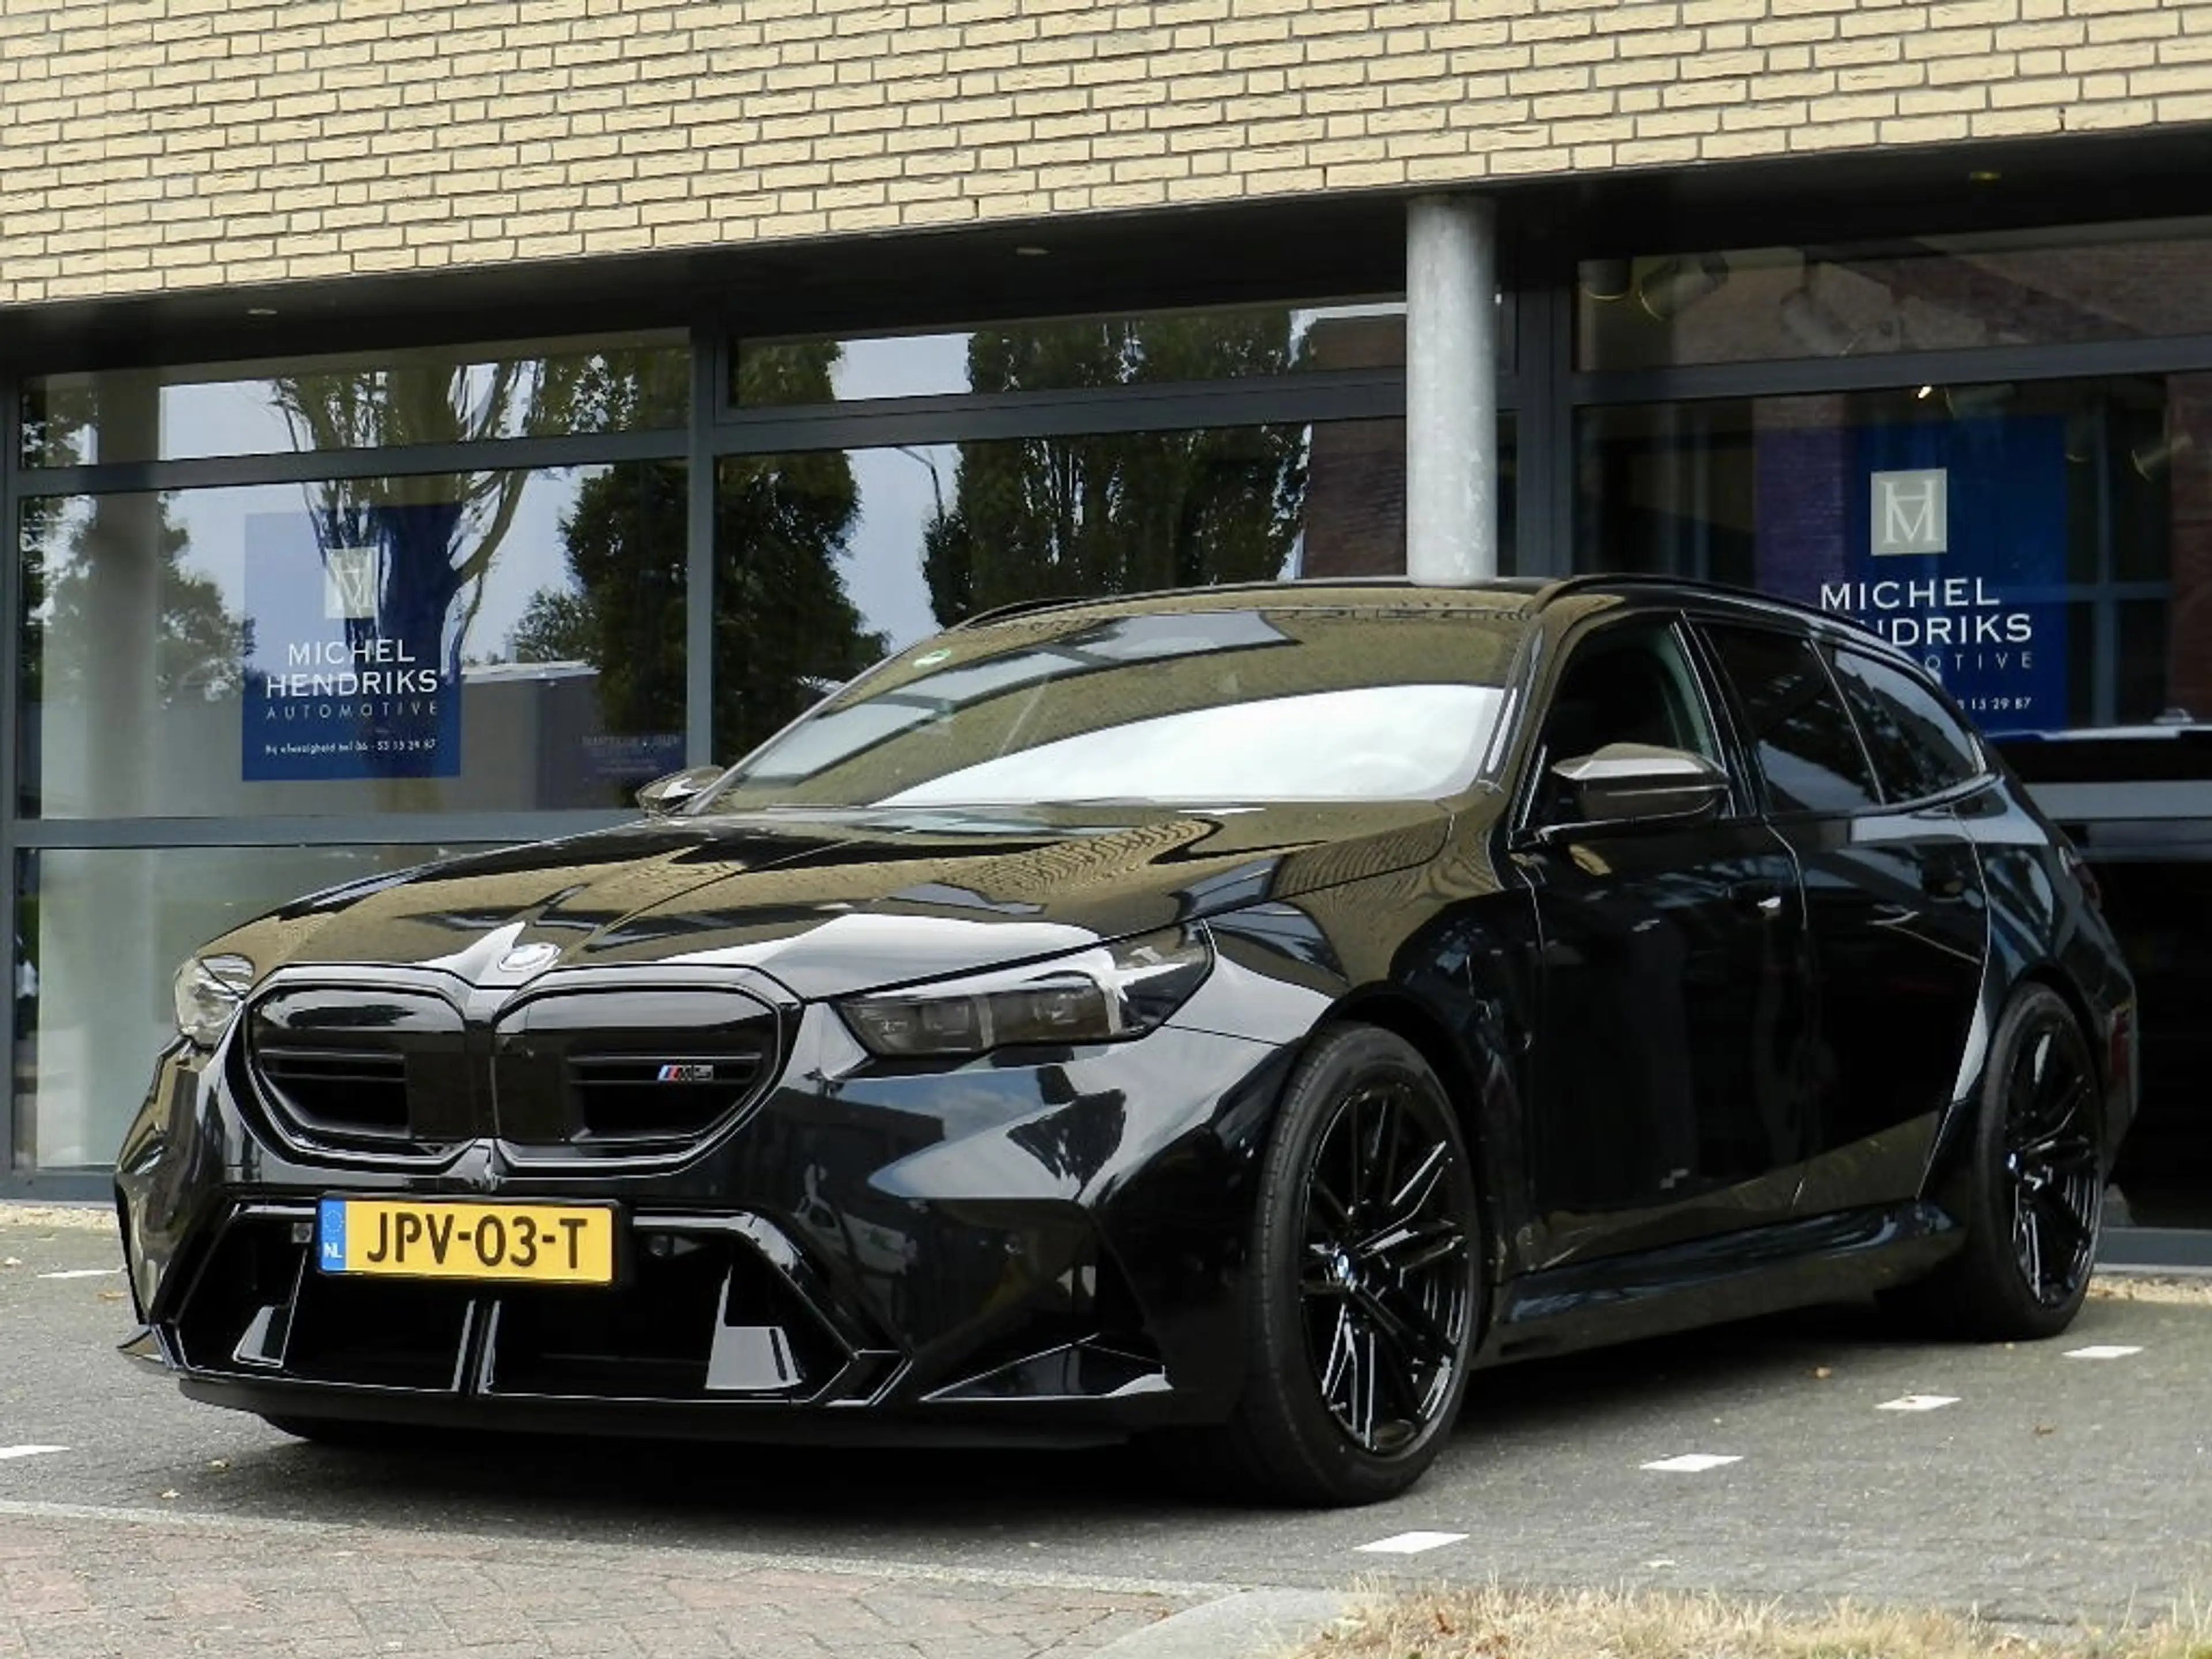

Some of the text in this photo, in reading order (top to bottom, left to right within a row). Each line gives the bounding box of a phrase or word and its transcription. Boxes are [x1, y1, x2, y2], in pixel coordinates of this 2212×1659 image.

[1820, 577, 2001, 611] MICHEL
[289, 639, 415, 667] MICHEL
[265, 669, 437, 699] HENDRIKS
[266, 700, 438, 720] AUTOMOTIVE
[323, 1242, 343, 1258] NL
[367, 1211, 588, 1269] JPV-03-T
